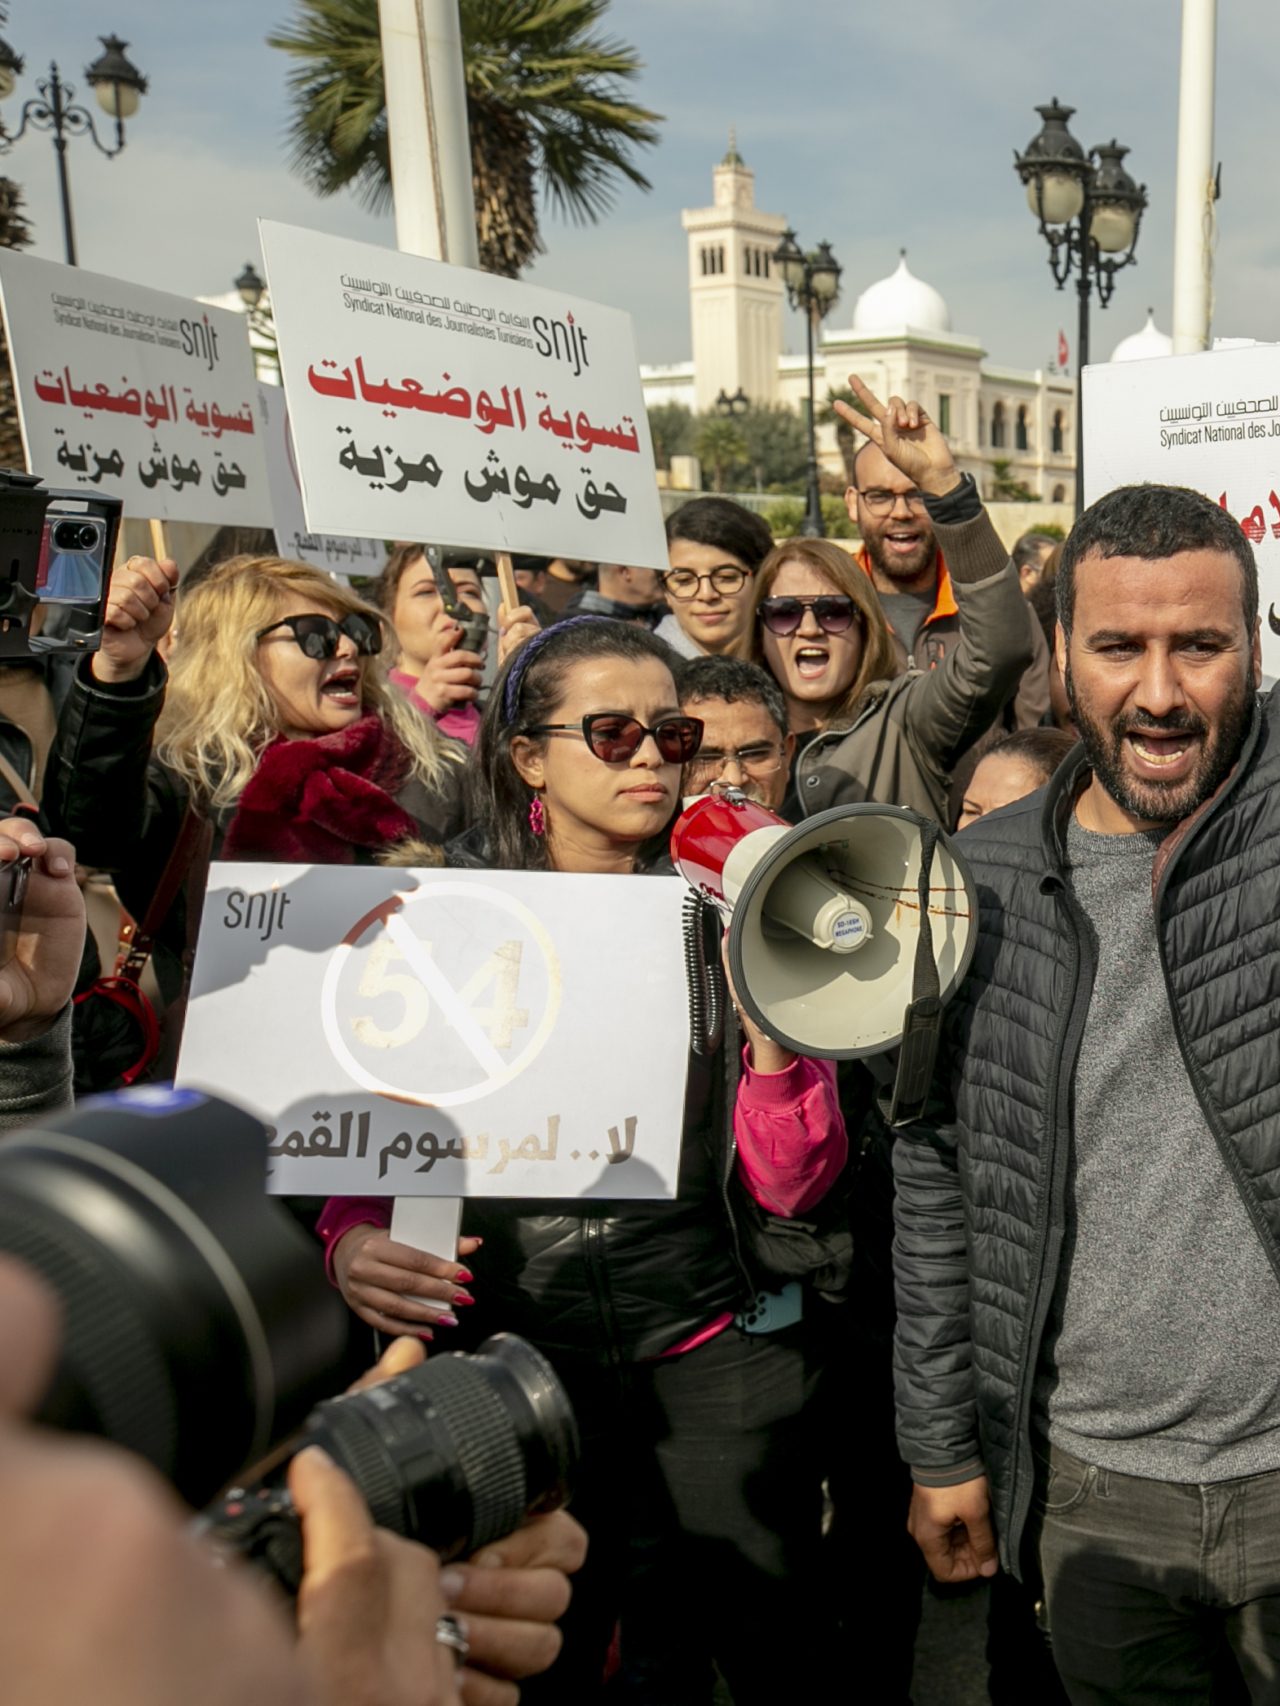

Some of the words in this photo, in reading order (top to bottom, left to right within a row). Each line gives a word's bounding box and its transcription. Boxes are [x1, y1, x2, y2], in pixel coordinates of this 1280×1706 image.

[179, 312, 219, 371] snjt
[343, 292, 385, 314] Syndicat
[386, 302, 425, 325] National
[426, 313, 443, 329] des
[444, 317, 496, 341] Journalistes
[496, 327, 534, 350] Tunisiens
[532, 310, 590, 377] snjt
[34, 366, 178, 429] الوضعيات
[185, 387, 254, 438] تسوية
[308, 355, 527, 434] الوضعيات
[535, 391, 640, 454] تسوية
[1159, 401, 1212, 424] التونسيين
[1216, 394, 1279, 419] للصحفيين
[54, 427, 125, 484] مزية
[336, 425, 443, 493] مزية
[1160, 426, 1202, 450] Syndicat
[1204, 421, 1246, 443] National
[1248, 417, 1267, 441] des
[138, 442, 202, 491] موش
[211, 450, 247, 496] حق
[464, 449, 562, 509] موش
[575, 466, 627, 520] حق
[223, 879, 291, 941] snjt
[348, 939, 530, 1050] 54
[378, 1113, 561, 1180] لمرسوم
